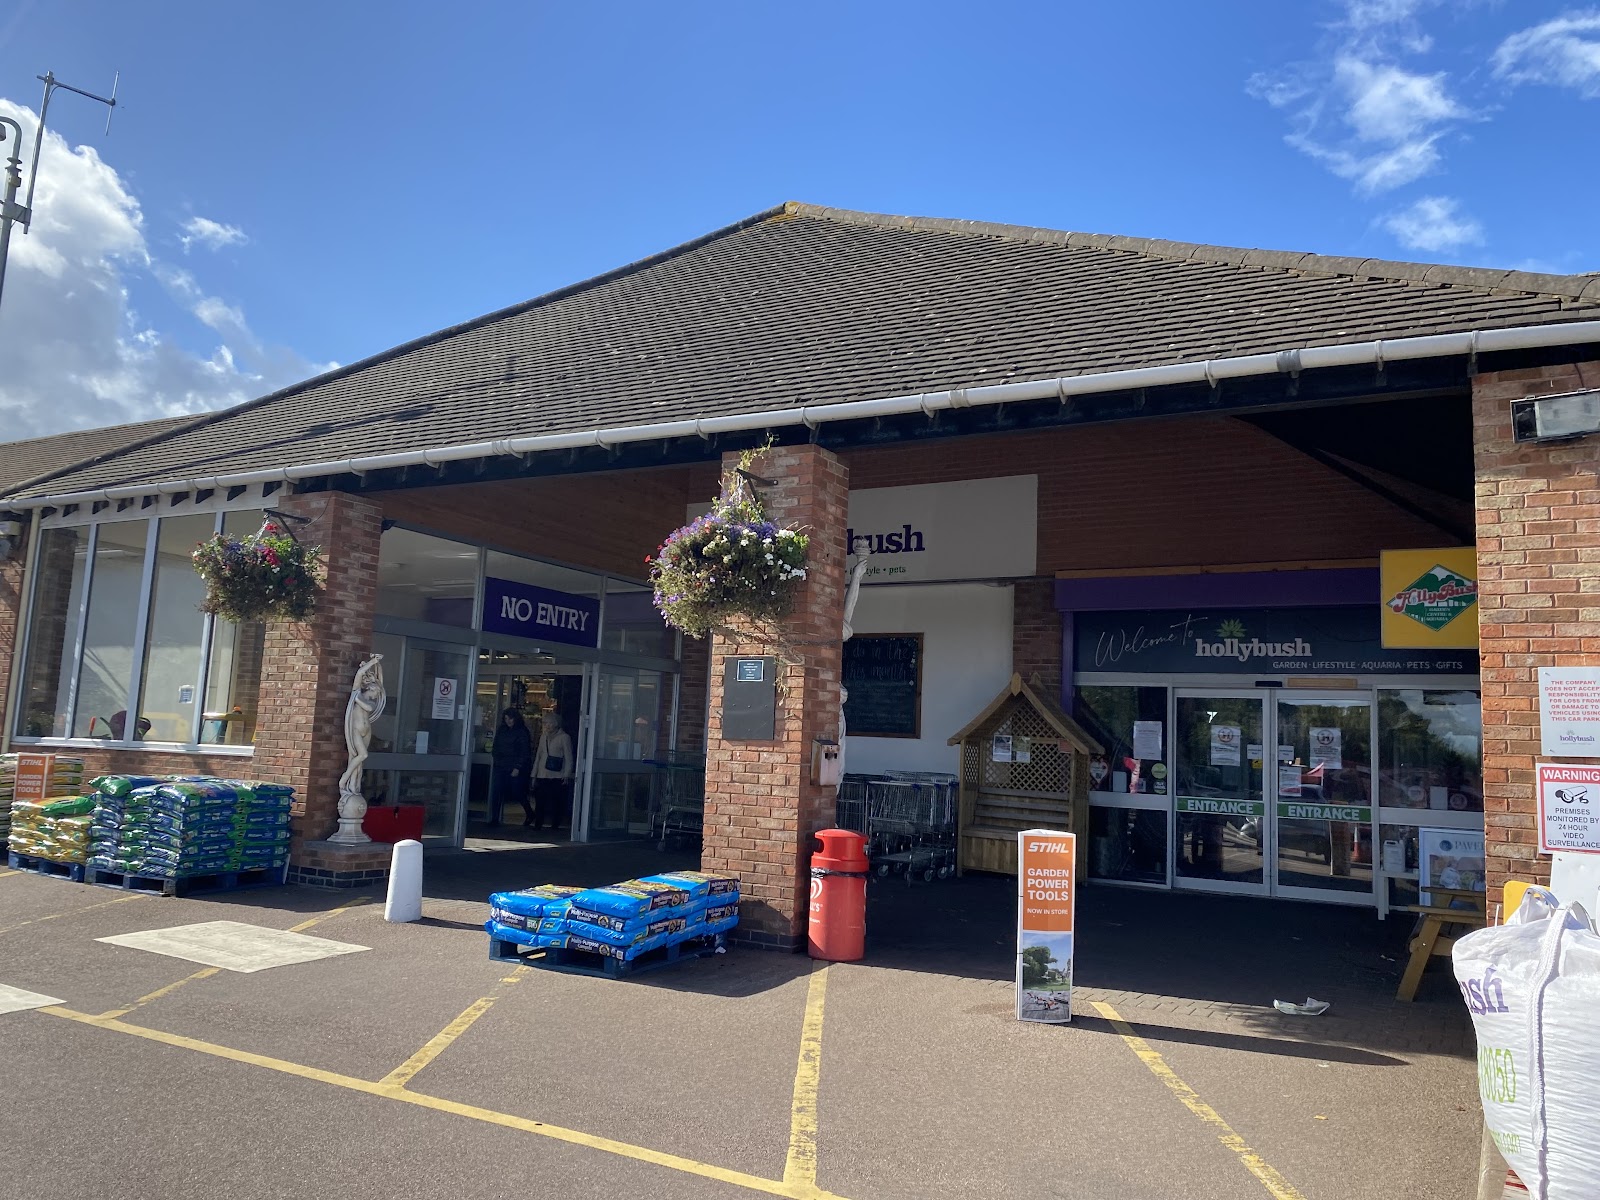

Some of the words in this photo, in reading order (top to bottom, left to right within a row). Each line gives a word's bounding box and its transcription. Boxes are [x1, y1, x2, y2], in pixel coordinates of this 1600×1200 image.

[889, 567, 906, 575] pets
[501, 596, 533, 622] NO
[536, 602, 589, 631] ENTRY
[1095, 626, 1176, 667] Welcome
[1195, 637, 1312, 663] hollybush
[1272, 661, 1308, 669] GARDEN
[1312, 661, 1355, 669] LIFESTYLE
[1360, 661, 1401, 670] AQUARIA
[1406, 661, 1430, 669] PETS
[1436, 661, 1462, 669] GIFTS
[1559, 735, 1595, 743] hollybush
[20, 758, 44, 766] STIHL
[1542, 769, 1600, 782] WARNING
[17, 779, 41, 787] POWER
[17, 786, 41, 794] TOOLS
[1186, 799, 1253, 814] ENTRANCE
[1555, 807, 1591, 815] PREMISES
[1287, 805, 1359, 821] ENTRANCE
[1546, 815, 1588, 823] MONITORED
[1562, 832, 1585, 840] VIDEO
[1028, 842, 1069, 854] STIHL
[1547, 839, 1600, 848] SURVEILLANCE
[1027, 868, 1069, 878] GARDEN
[1027, 878, 1069, 889] POWER
[1027, 889, 1069, 901] TOOLS
